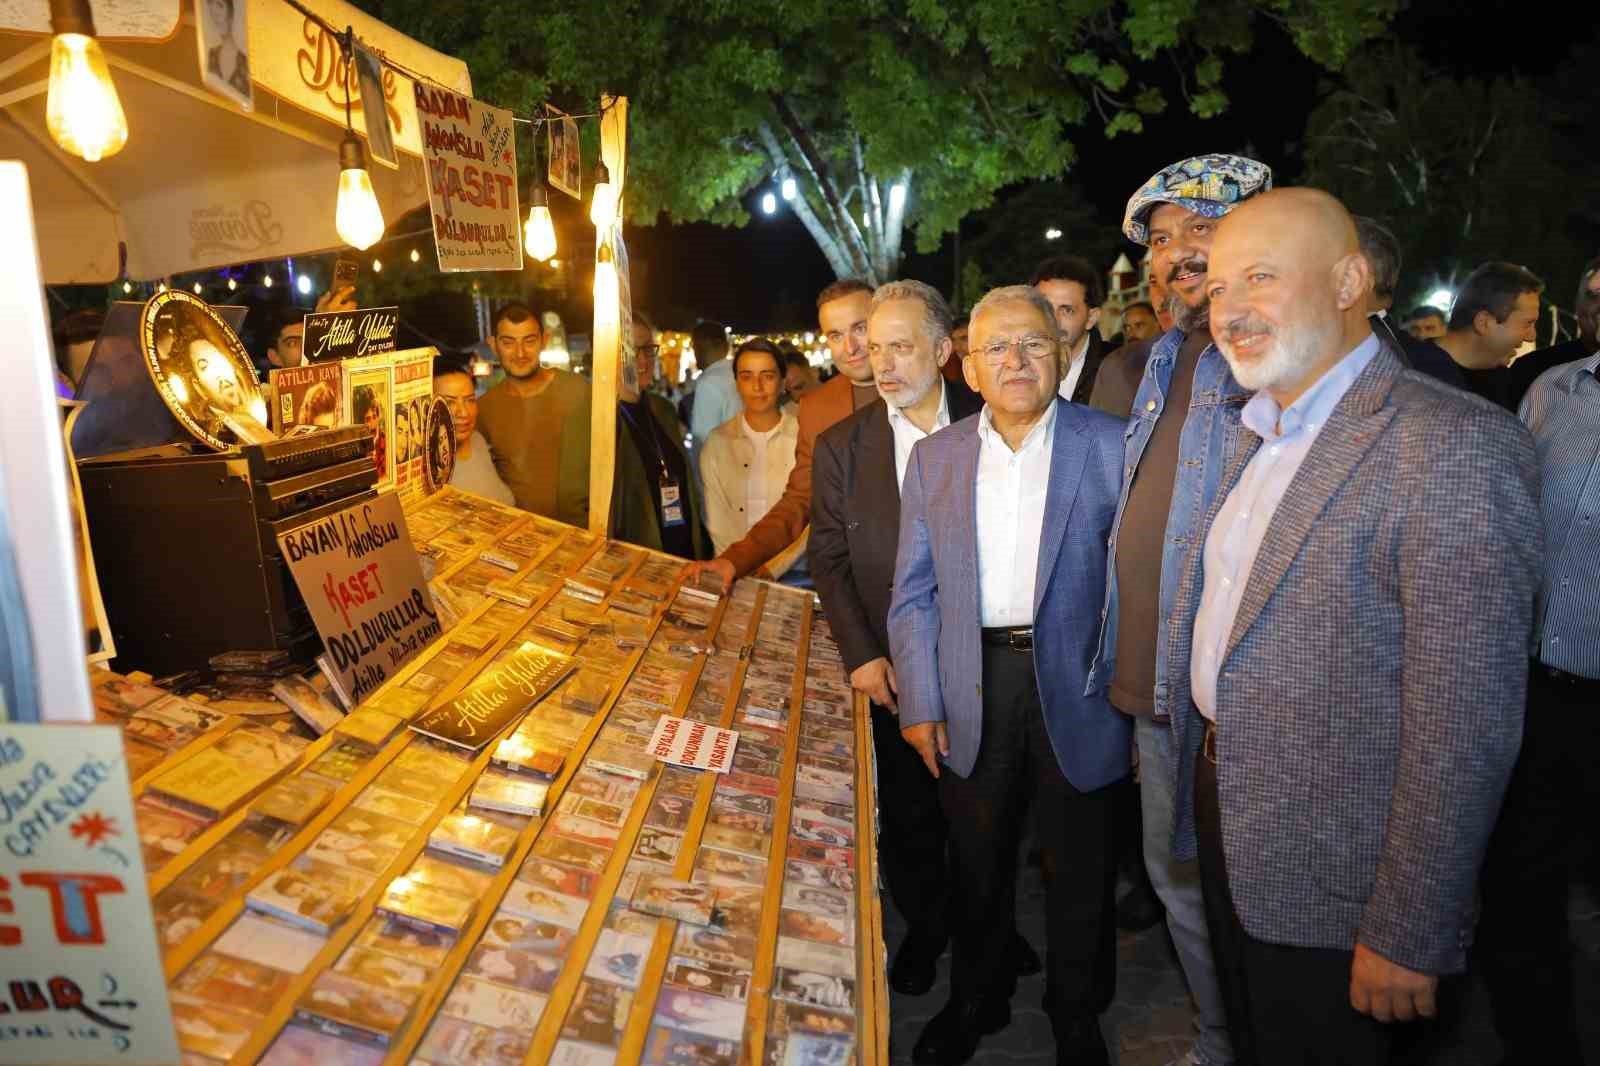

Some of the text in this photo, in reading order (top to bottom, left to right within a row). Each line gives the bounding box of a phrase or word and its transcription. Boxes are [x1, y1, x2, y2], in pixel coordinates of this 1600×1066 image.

[429, 157, 513, 218] KASET
[284, 517, 342, 562] BAYAN
[322, 562, 384, 629] KASET
[326, 588, 437, 673] DOLDURULUR
[708, 731, 731, 768] YASAKTIR
